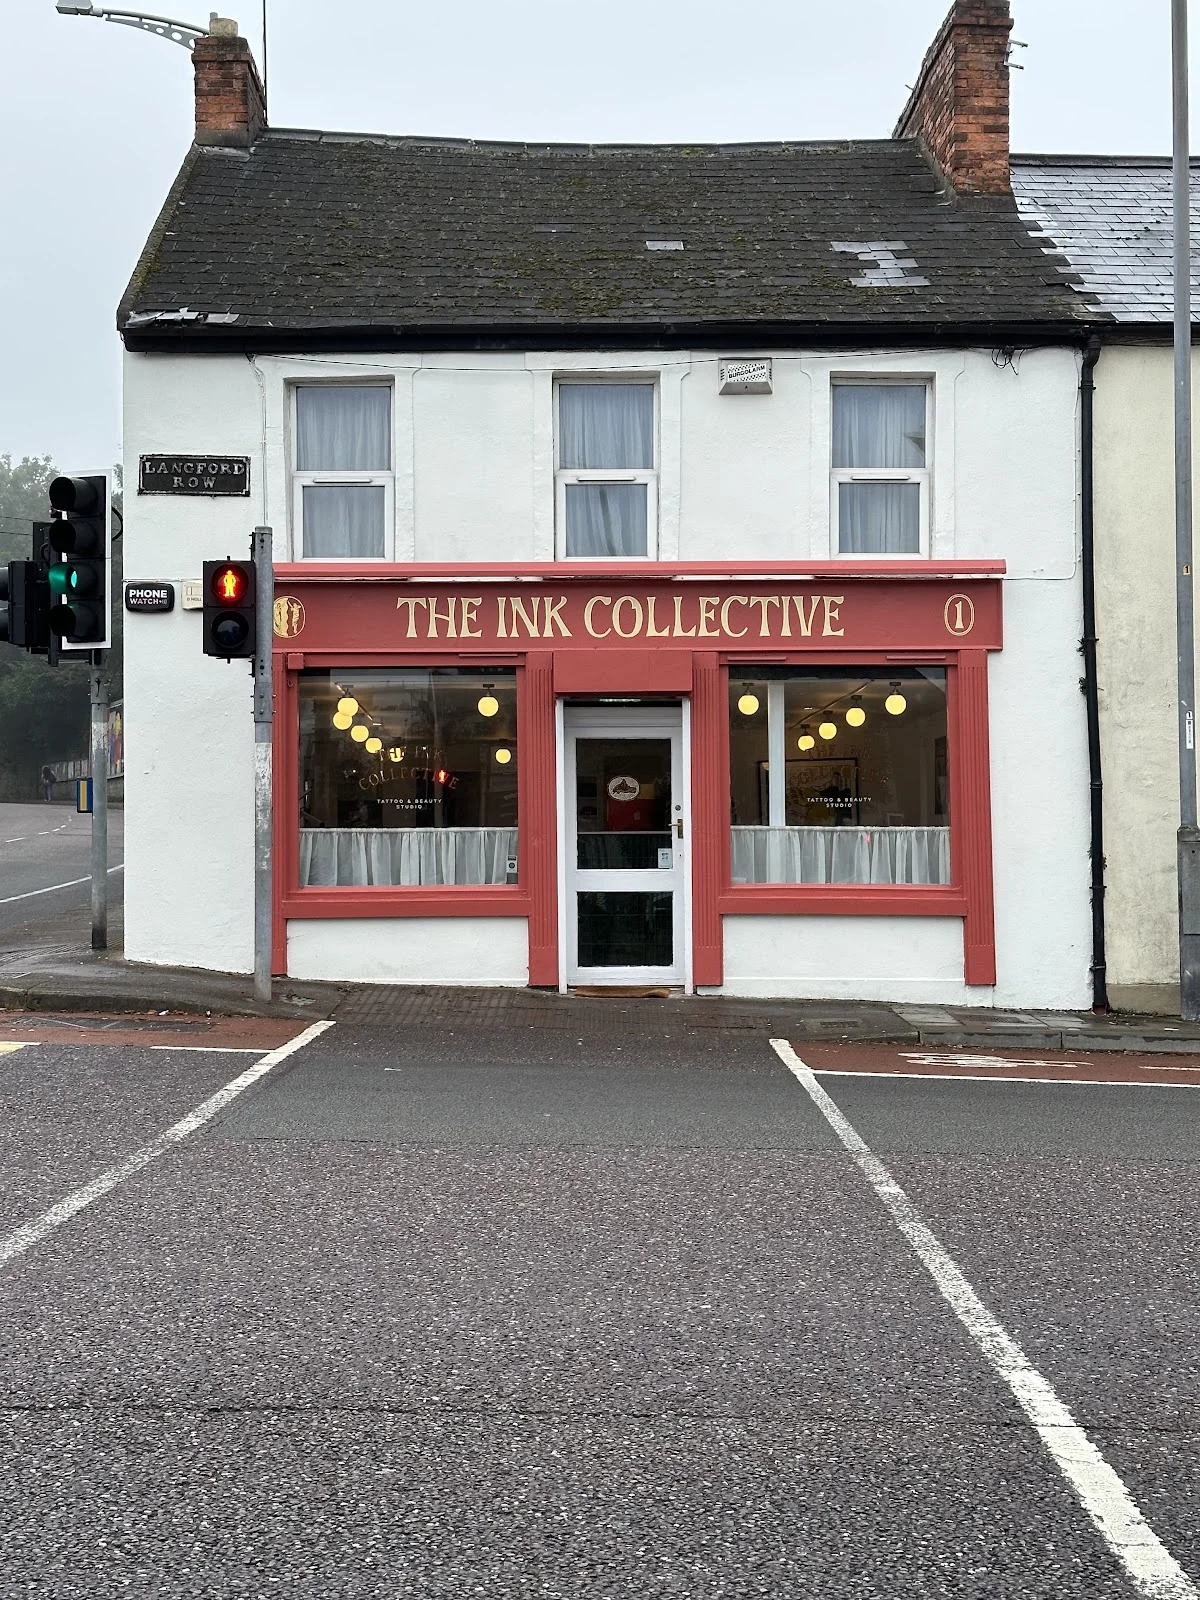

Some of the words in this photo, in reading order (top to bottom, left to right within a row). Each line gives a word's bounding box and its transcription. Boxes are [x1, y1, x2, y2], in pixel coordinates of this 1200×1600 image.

[144, 461, 245, 475] LANGFORD
[172, 476, 216, 488] ROW
[129, 589, 168, 598] PHONE
[396, 597, 482, 638] THE
[496, 596, 573, 638] INK
[584, 595, 845, 638] COLLECTIVE
[954, 600, 964, 629] 1
[359, 767, 459, 790] COLLECTIVE
